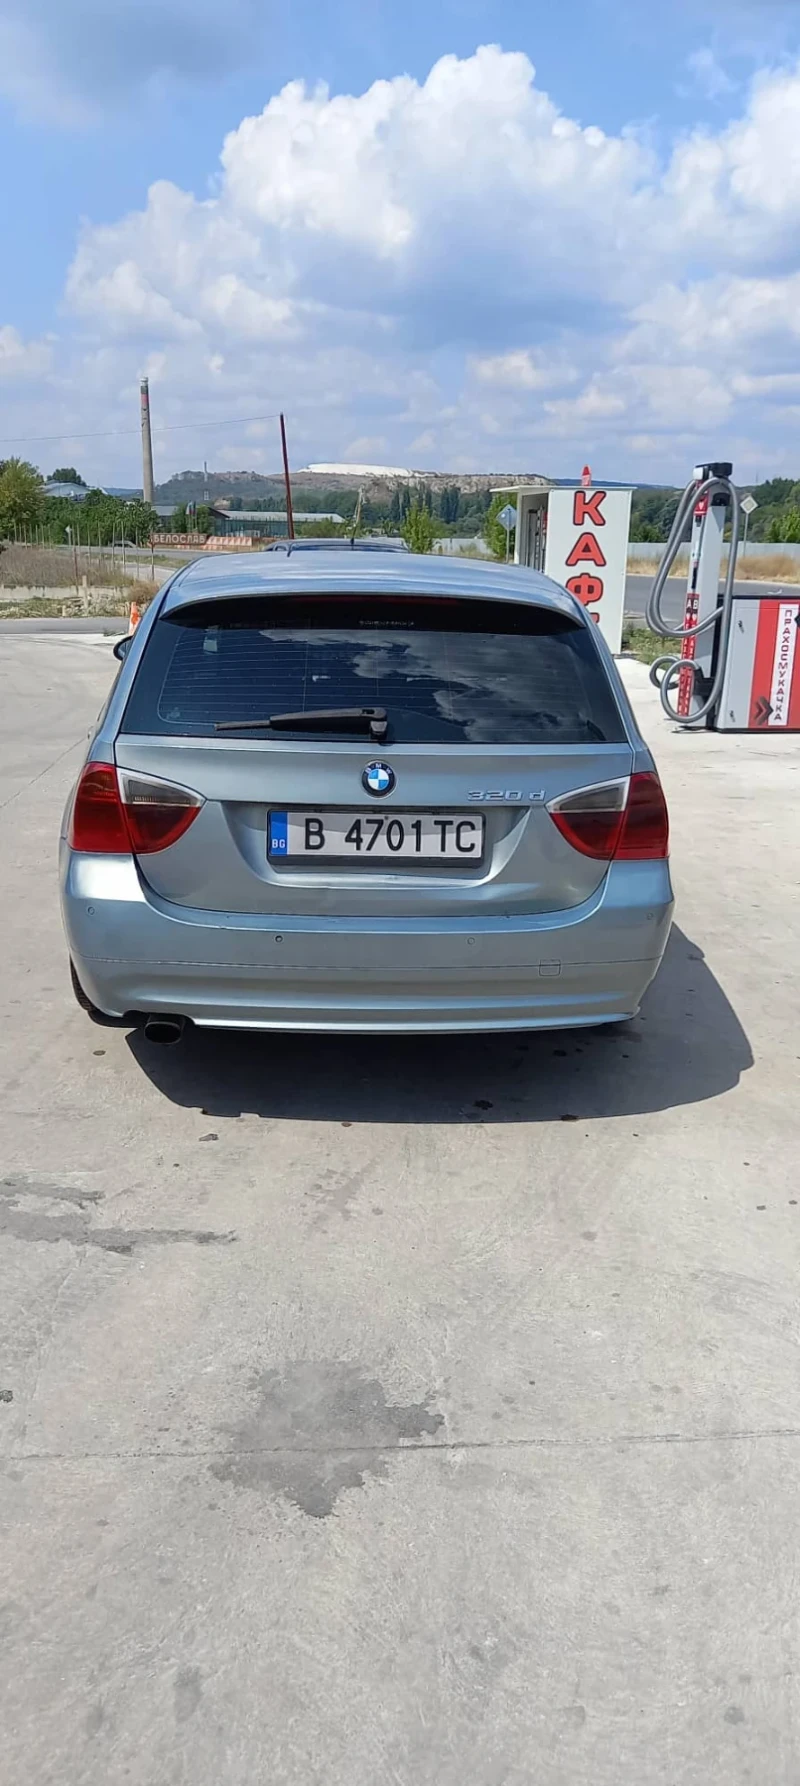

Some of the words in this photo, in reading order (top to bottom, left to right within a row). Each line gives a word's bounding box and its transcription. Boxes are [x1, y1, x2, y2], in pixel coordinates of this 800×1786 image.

[565, 490, 606, 623] КАФ
[774, 609, 792, 720] ПРАХОСМУКАЧКА
[271, 838, 286, 849] BG
[304, 818, 325, 850] B
